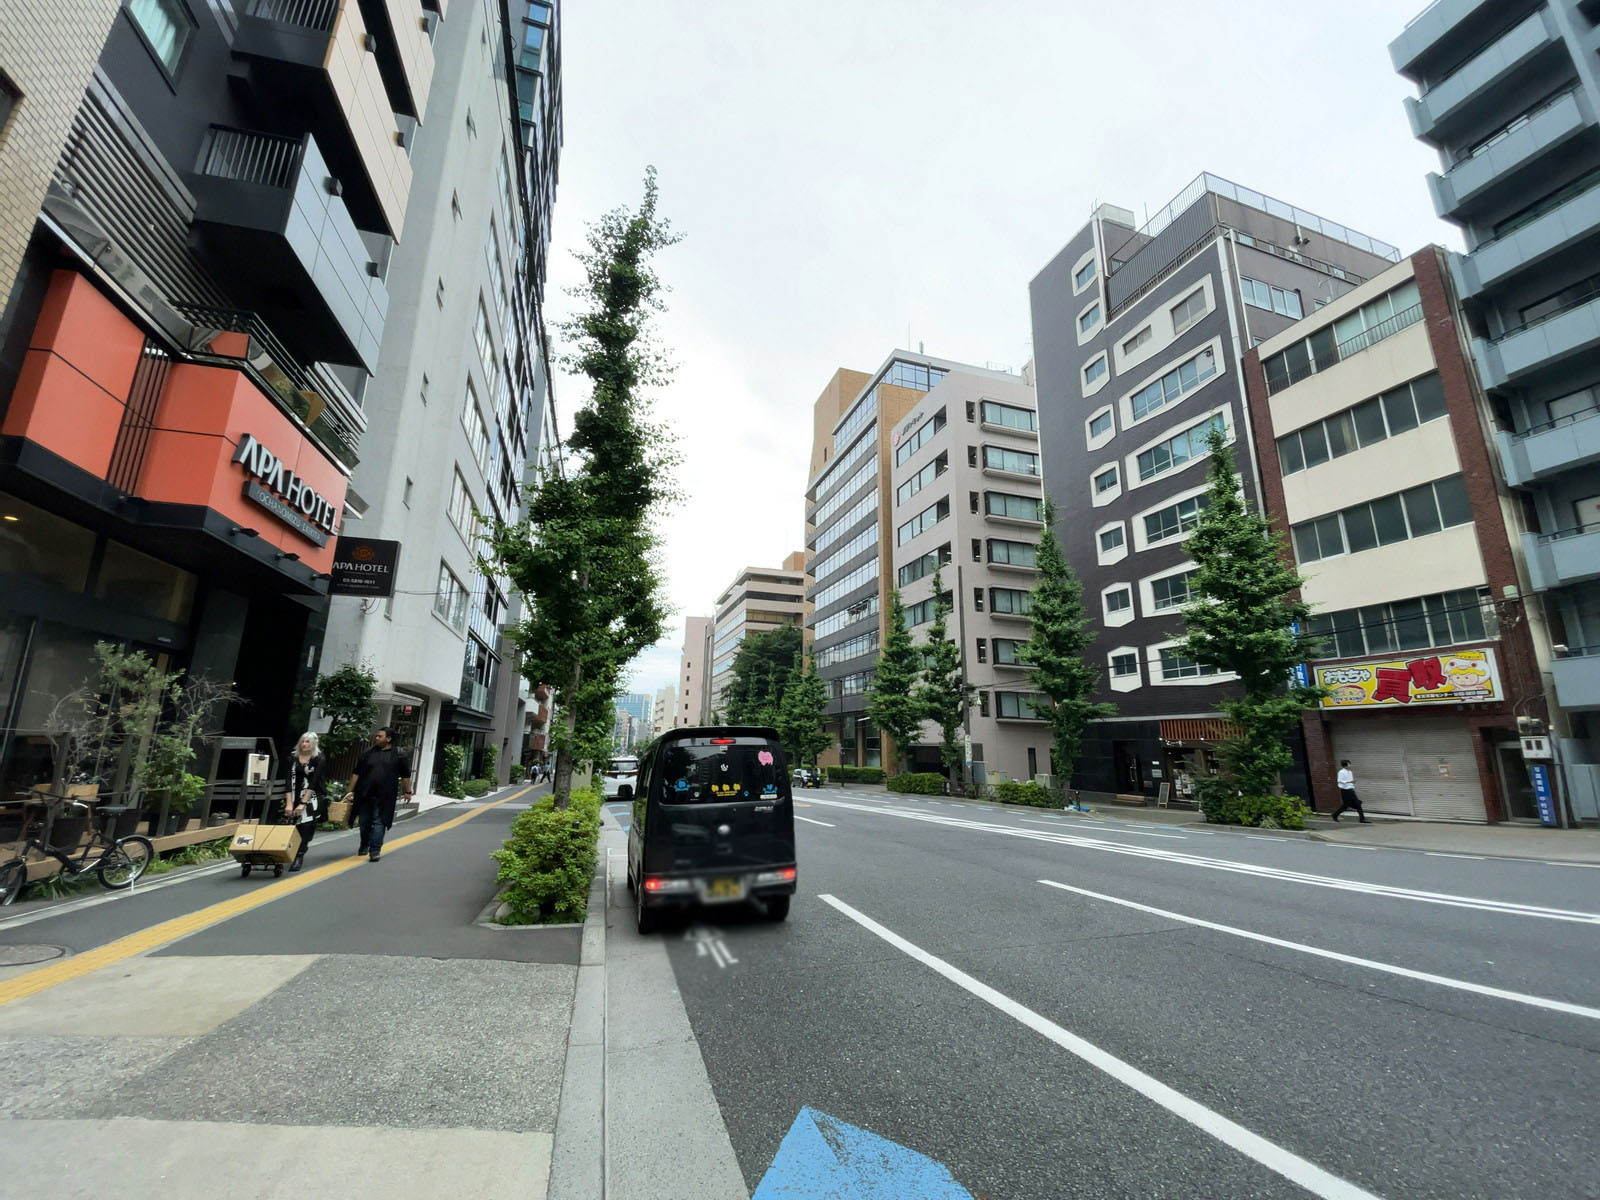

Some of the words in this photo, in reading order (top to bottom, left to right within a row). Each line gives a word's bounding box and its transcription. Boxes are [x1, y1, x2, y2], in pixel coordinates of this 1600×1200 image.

[239, 434, 284, 494] APA
[286, 471, 339, 535] HOTEL
[332, 561, 353, 571] APA
[354, 563, 389, 573] HOTEL
[1323, 668, 1371, 685] おもちゃ
